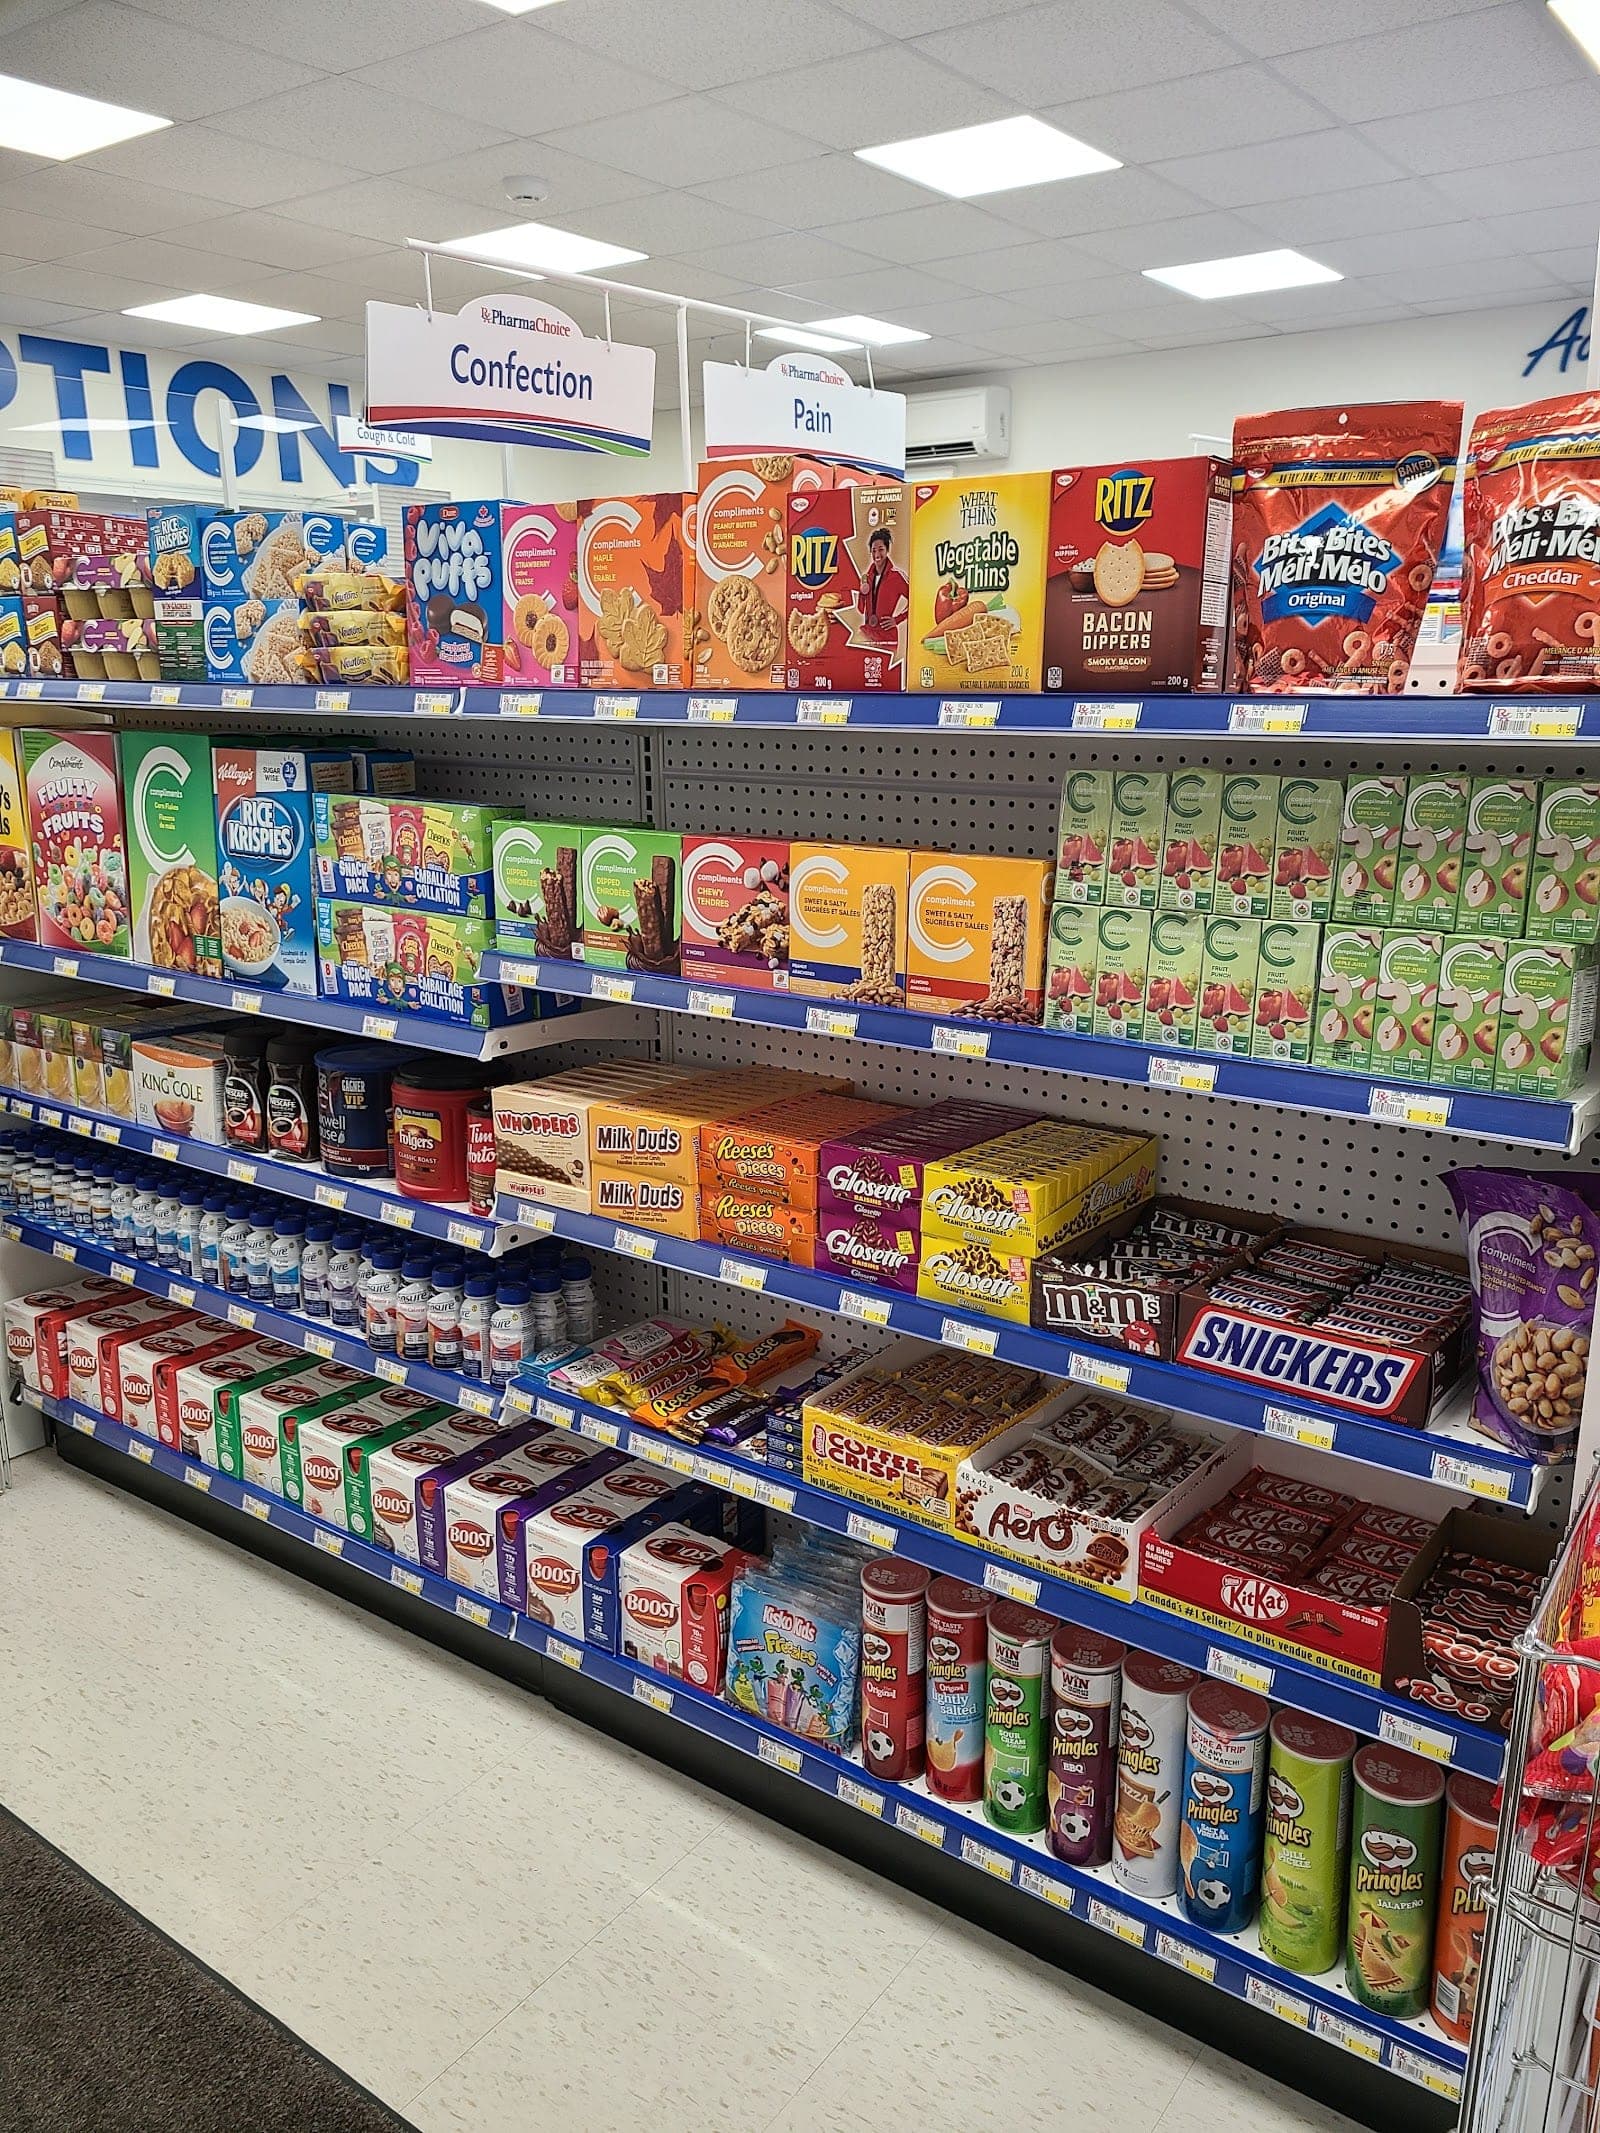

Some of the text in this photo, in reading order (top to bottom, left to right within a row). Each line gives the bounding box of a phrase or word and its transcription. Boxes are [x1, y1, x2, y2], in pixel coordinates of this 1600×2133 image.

[492, 309, 571, 337] PharmaChoice
[451, 344, 592, 401] Confection
[794, 398, 832, 434] Pain
[357, 426, 415, 447] Cough & Cold
[1399, 459, 1432, 477] BAKED
[959, 491, 998, 508] WHEAT
[1095, 476, 1154, 523] RITZ
[713, 506, 764, 518] compliments
[160, 518, 178, 536] RICE
[713, 520, 758, 530] PEANUT BUTTER
[156, 529, 189, 553] KRISPIES
[593, 538, 641, 550] compliments
[1325, 525, 1391, 561] Bites
[514, 547, 556, 558] compliments
[791, 534, 839, 578] RITZ
[937, 532, 1017, 574] Vegetable
[964, 563, 1008, 590] Thins
[1502, 569, 1582, 589] Cheddar
[790, 591, 814, 601] original
[1288, 592, 1345, 608] Original
[1083, 611, 1152, 633] BACON
[1082, 633, 1151, 650] DIPPERS
[1087, 657, 1147, 666] SMOKY BACON
[1167, 676, 1189, 688] 200 g
[1284, 721, 1301, 732] 3.99
[1557, 724, 1576, 735] 3.99
[217, 762, 255, 786] Kellogg's
[37, 776, 98, 808] FRUITY
[241, 799, 274, 828] RICE
[42, 811, 104, 840] FRUITS
[229, 822, 294, 858] KRISPIES
[339, 860, 369, 877] SNACK
[505, 855, 543, 866] compliments
[595, 863, 637, 875] compliments
[346, 876, 369, 893] PACK
[414, 866, 460, 890] EMBALLAGE
[697, 873, 743, 885] compliments
[415, 884, 460, 908] COLLATION
[697, 887, 724, 898] CHEWY
[804, 884, 848, 896] compliments
[697, 897, 730, 908] TENDRES
[804, 897, 847, 908] SWEET & SALTY
[804, 905, 830, 915] SUCRÉES
[838, 908, 861, 918] SALÉES
[925, 895, 976, 908] compliments
[925, 909, 974, 920] SWEET & SALTY
[925, 917, 989, 931] SUCRÉES ET SALÉES
[342, 965, 372, 984] SNACK
[349, 981, 372, 998] PACK
[418, 975, 465, 1000] EMBALLAGE
[419, 993, 465, 1016] COLLATION
[141, 1071, 204, 1103] KING COLE
[341, 1079, 366, 1093] GAGNER
[344, 1095, 365, 1105] VIP
[496, 1112, 580, 1138] WHOPPERS
[1425, 1111, 1444, 1123] 2.99
[399, 1129, 434, 1151] Folgers
[469, 1123, 493, 1143] Tim
[598, 1126, 681, 1153] Milk Duds
[398, 1152, 437, 1164] CLASSIC ROAST
[716, 1136, 775, 1161] Reese's
[736, 1160, 786, 1181] pieces
[508, 1183, 547, 1197] WHOPPERS
[600, 1180, 683, 1209] Milk Duds
[827, 1165, 912, 1204] Glosette
[716, 1194, 775, 1219] Reese's
[853, 1195, 882, 1206] RAISINS
[928, 1188, 1026, 1231] Glosette
[735, 1218, 785, 1239] pieces
[943, 1218, 1008, 1237] PEANUTS ARACHIDES
[825, 1229, 909, 1271] Glosette
[1481, 1244, 1538, 1274] compliments
[925, 1255, 1022, 1300] Glosette
[940, 1283, 1004, 1306] PEANUTS ARACHIDES
[8, 1334, 36, 1349] BOOST
[70, 1354, 97, 1370] BOOST
[734, 1335, 780, 1370] Reese
[1193, 1316, 1405, 1407] SNICKERS
[123, 1379, 152, 1396] BOOST
[652, 1383, 703, 1417] Reese
[687, 1388, 744, 1422] CARAMILK
[181, 1404, 212, 1422] BOOST
[243, 1432, 278, 1450] BOOST
[828, 1433, 921, 1477] COFFEE
[828, 1447, 901, 1482] CRISP
[304, 1462, 342, 1482] BOOST
[960, 1471, 970, 1481] 48
[977, 1479, 987, 1490] 42
[1488, 1482, 1507, 1496] 3.49
[374, 1494, 415, 1516] BOOST
[450, 1526, 494, 1549] BOOST
[1145, 1543, 1174, 1559] 48 BARS
[530, 1563, 580, 1586] BOOST
[627, 1592, 680, 1619] BOOST
[1229, 1579, 1286, 1618] KitKat
[763, 1604, 817, 1642] Kisko Kids
[1144, 1590, 1183, 1612] Canada's
[1243, 1626, 1253, 1639] La
[1255, 1633, 1276, 1649] plus
[1278, 1641, 1313, 1662] vendue
[1315, 1654, 1328, 1668] au
[764, 1629, 817, 1667] Freezies
[1425, 1634, 1519, 1676] Rolo
[928, 1659, 967, 1681] Pringles
[866, 1681, 897, 1699] Original
[1410, 1679, 1490, 1722] Rolo
[940, 1703, 977, 1716] salted
[987, 1705, 1030, 1729] Pringles
[1052, 1736, 1099, 1760] Pringles
[1215, 1741, 1223, 1751] A
[1223, 1745, 1247, 1755] TRIP
[1063, 1761, 1085, 1774] BBQ
[1187, 1799, 1240, 1826] Pringles
[1357, 1866, 1424, 1896] Pringles
